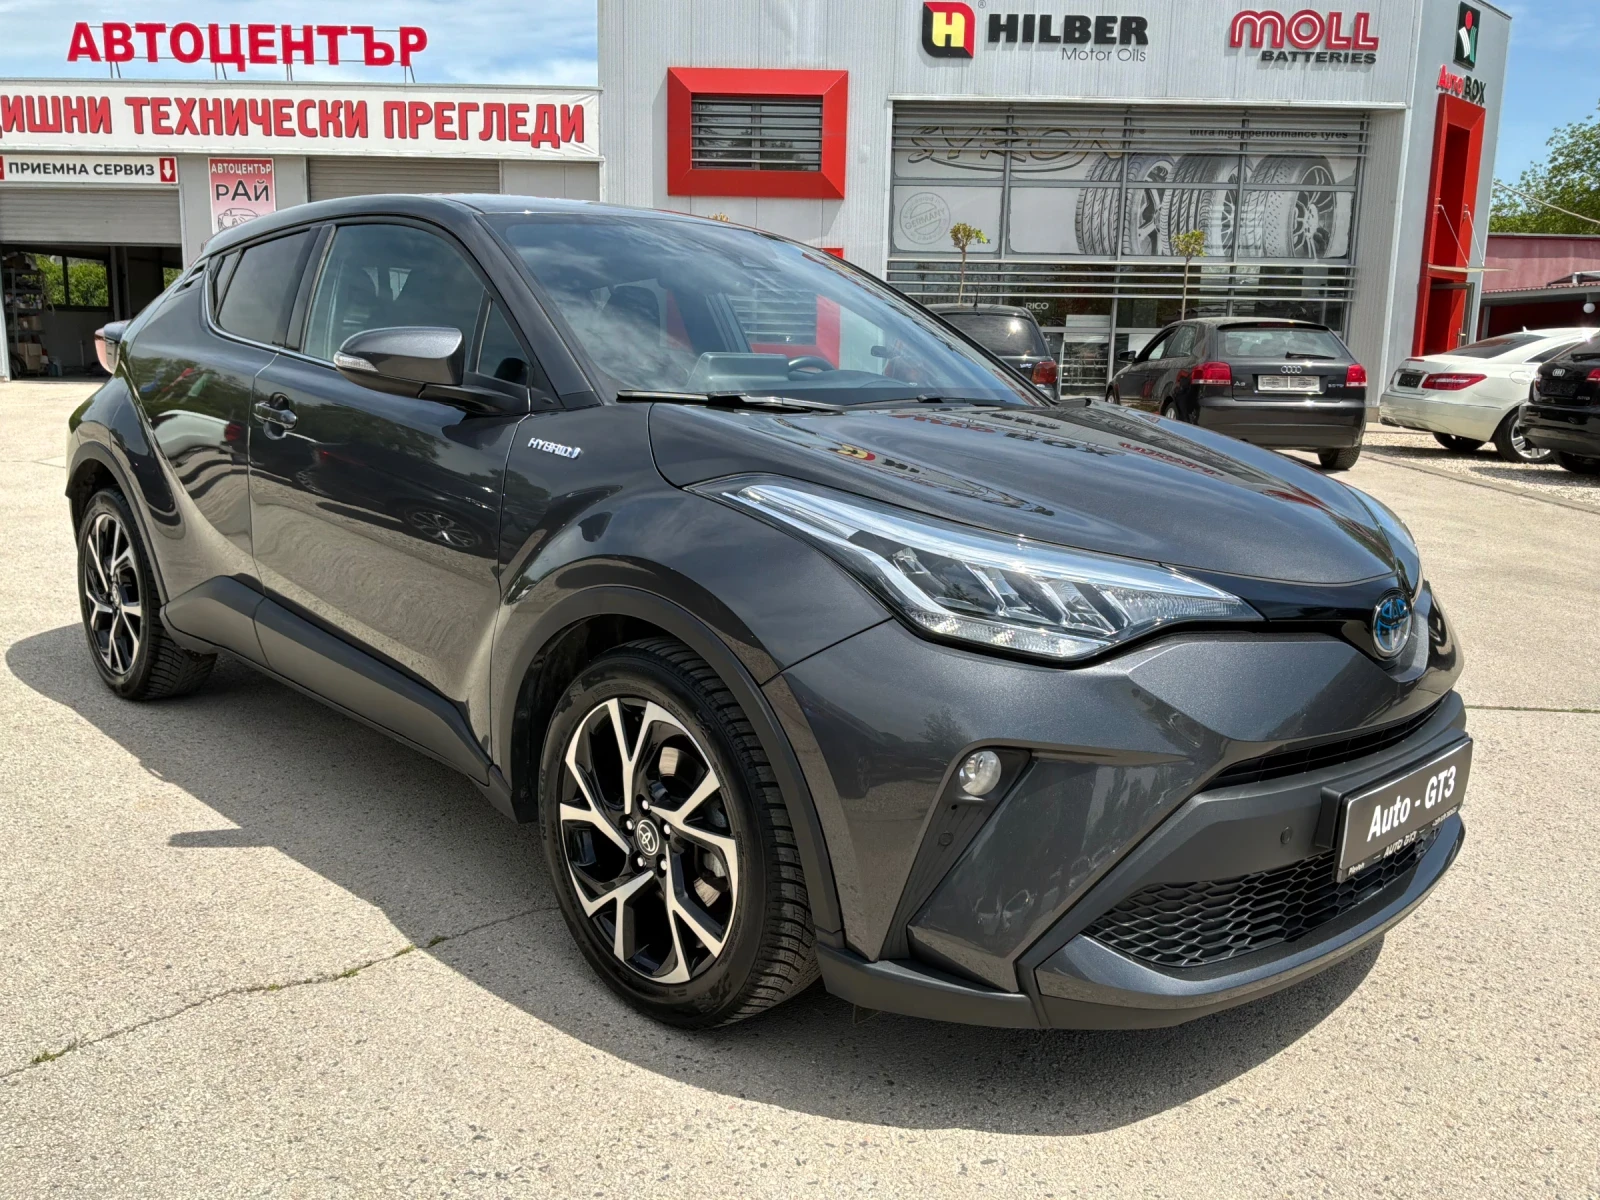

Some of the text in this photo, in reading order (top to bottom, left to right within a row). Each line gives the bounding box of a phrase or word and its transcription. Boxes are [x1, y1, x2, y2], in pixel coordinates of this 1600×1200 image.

[988, 14, 1148, 45] HILBER
[1230, 9, 1379, 51] MOLL
[67, 22, 428, 72] АВТОЦЕНТЪР
[1061, 48, 1147, 62] Motor Oils
[1261, 50, 1376, 64] BATTERIES
[0, 94, 585, 149] ИШНИ ТЕХНИЧЕСКИ ПРЕГЛЕДИ
[8, 162, 155, 176] ПРИЕМНА СЕРВИЗ
[210, 163, 272, 176] АВТОЦЕНТЪР
[904, 207, 946, 231] GERMANY
[1025, 302, 1049, 310] RICO
[527, 437, 573, 458] HYBRID
[1366, 795, 1411, 842] Auto
[1424, 765, 1457, 809] GT3
